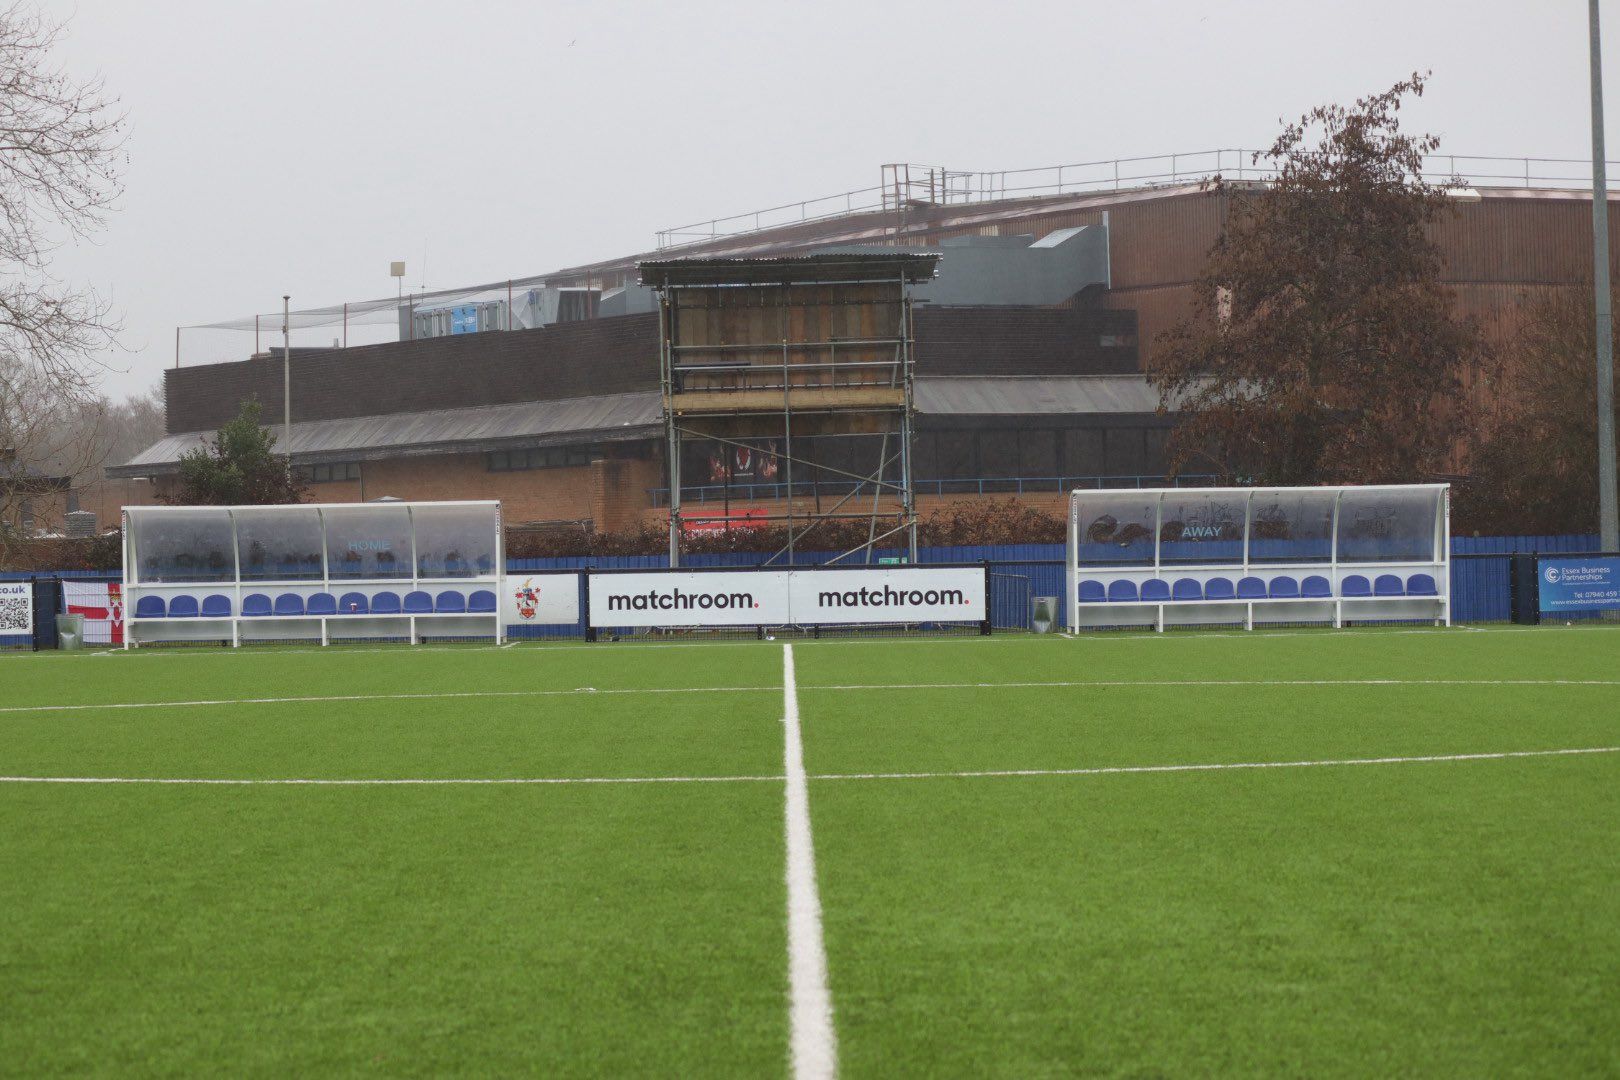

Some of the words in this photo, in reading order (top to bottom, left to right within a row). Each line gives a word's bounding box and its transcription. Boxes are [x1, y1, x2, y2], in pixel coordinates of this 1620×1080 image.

[1182, 526, 1222, 537] AWAY
[348, 538, 392, 550] HOME
[1562, 573, 1603, 581] Partnerships
[0, 585, 25, 594] o.uk
[608, 588, 759, 611] matchroom.
[818, 584, 970, 607] matchroom.
